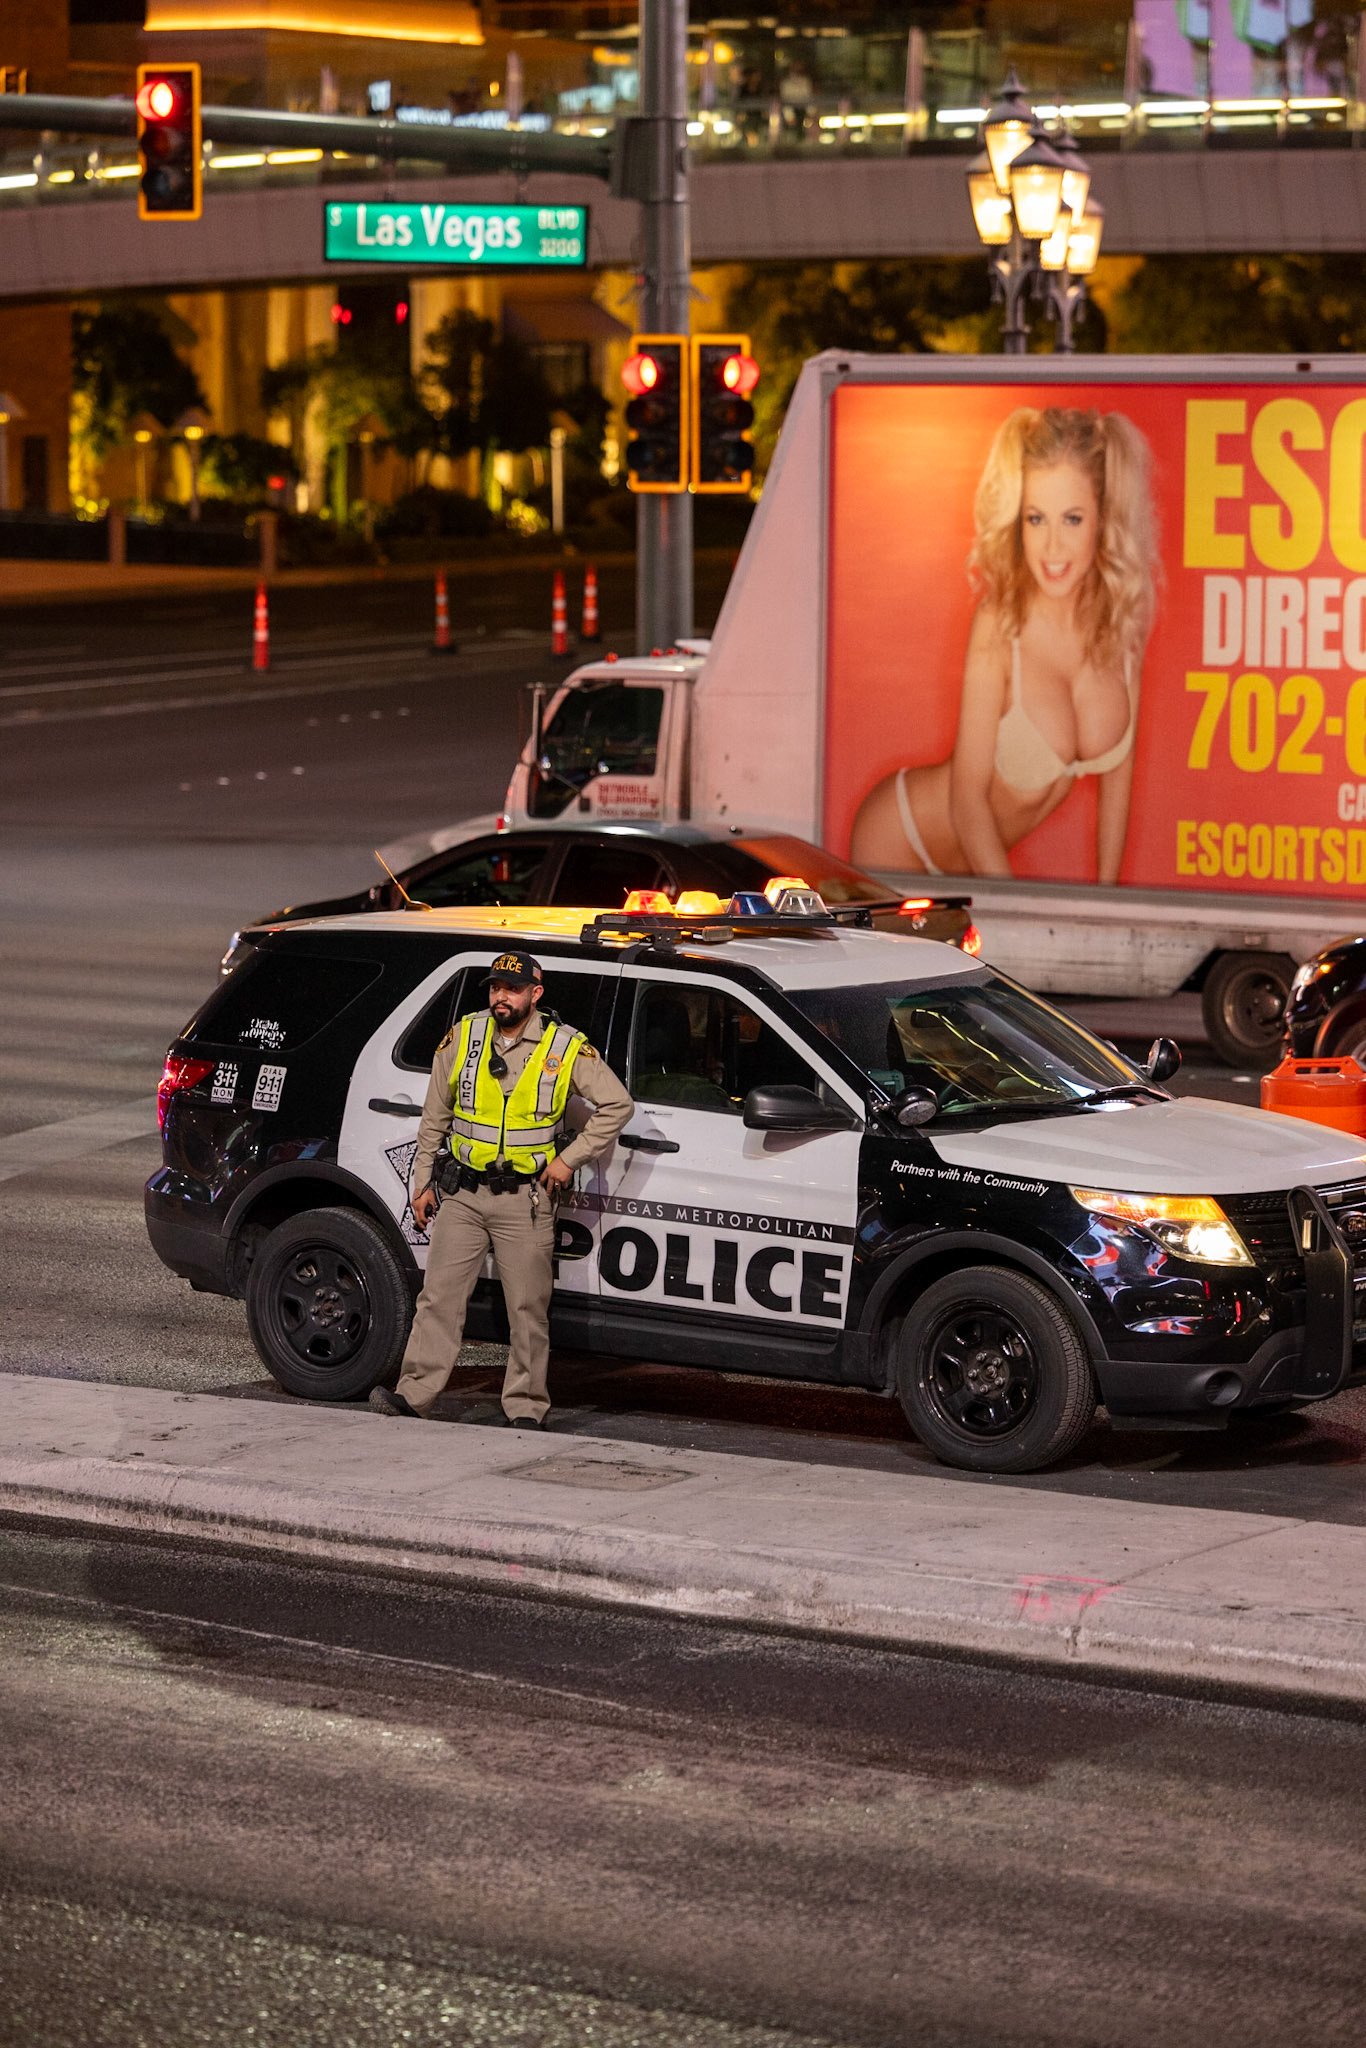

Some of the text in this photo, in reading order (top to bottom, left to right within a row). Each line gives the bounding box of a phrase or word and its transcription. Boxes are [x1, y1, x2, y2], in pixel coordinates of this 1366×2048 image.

[331, 204, 523, 260] S Las Vegas
[538, 209, 579, 230] BLVD
[1202, 575, 1366, 671] DIREC
[1176, 820, 1366, 885] ESCORTSD
[493, 960, 523, 974] POLICE
[218, 1062, 238, 1071] DIAL
[263, 1067, 282, 1076] DIAL
[461, 1040, 481, 1100] POLICE
[213, 1088, 233, 1098] NON
[890, 1160, 1049, 1197] Partners with the Community
[602, 1198, 664, 1218] VEGAS
[676, 1207, 833, 1239] METROPOLITAN
[552, 1218, 844, 1320] POLICE
